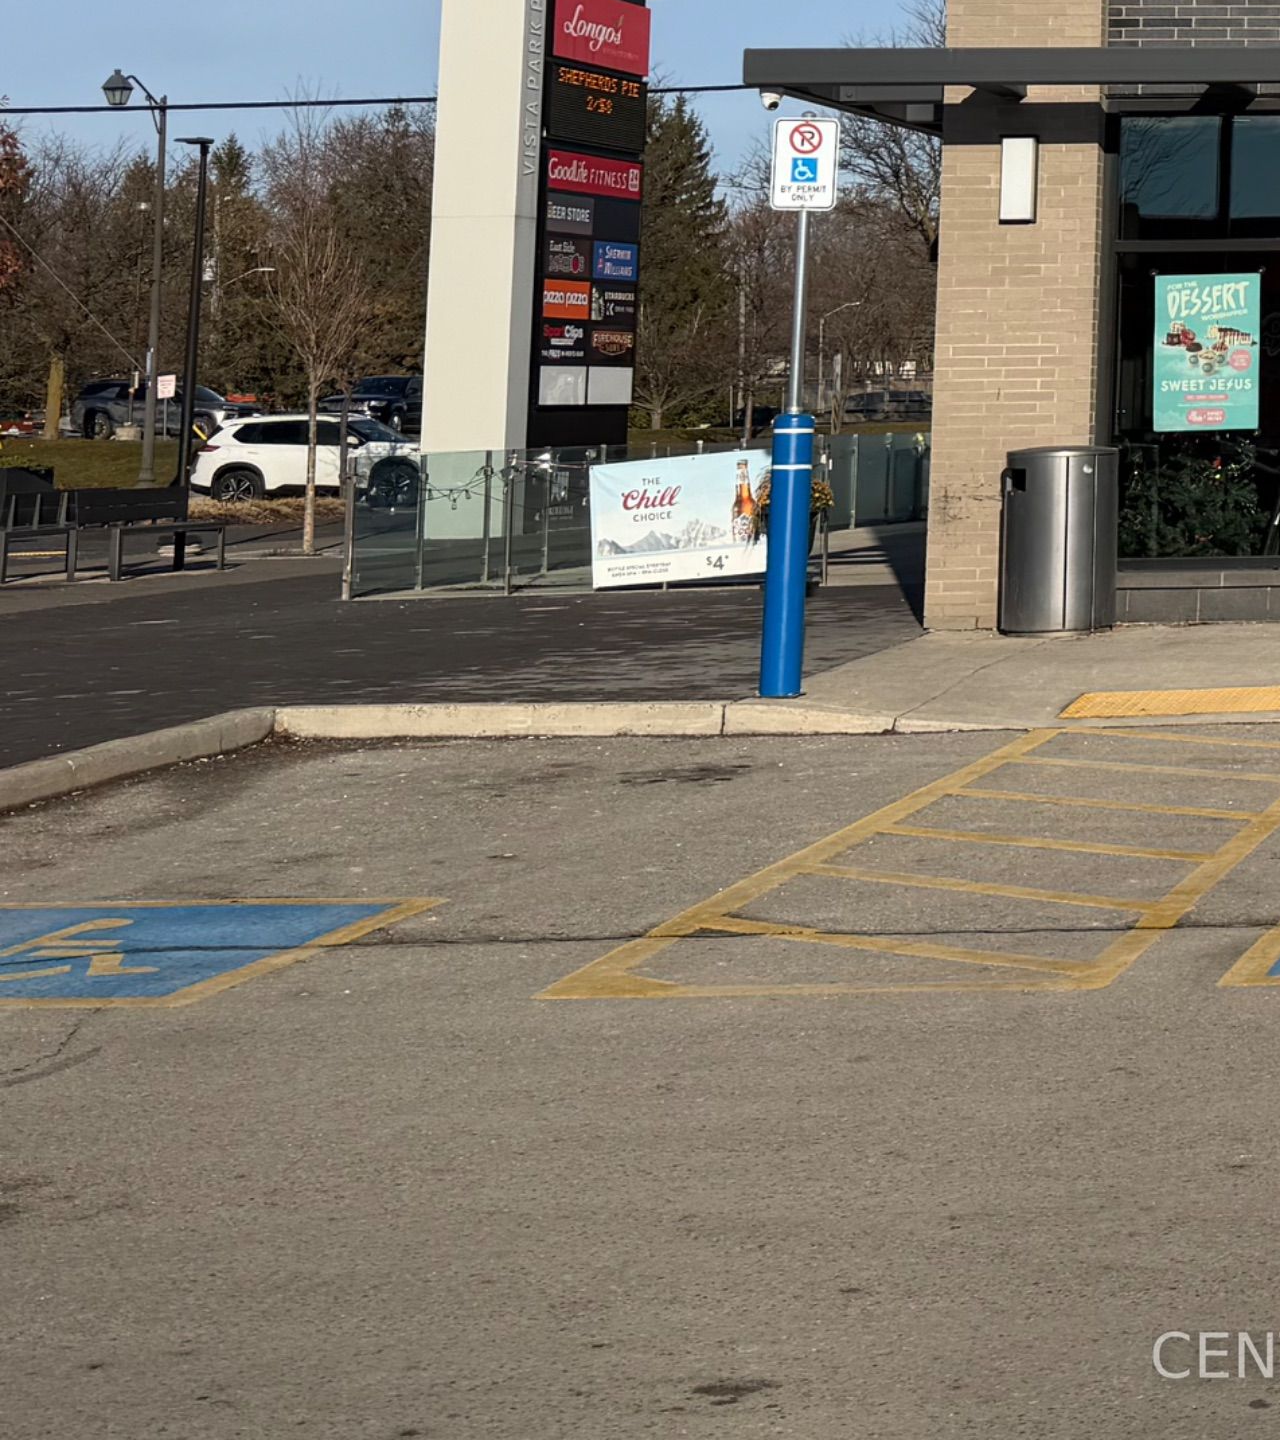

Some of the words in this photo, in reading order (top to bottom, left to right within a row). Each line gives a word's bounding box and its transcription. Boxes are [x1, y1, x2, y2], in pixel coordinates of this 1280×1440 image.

[527, 20, 543, 91] PARK
[557, 66, 618, 93] SHEPHERDS
[621, 80, 640, 98] PIE
[523, 99, 540, 176] VISTA
[589, 168, 627, 189] FITNESS
[567, 207, 590, 223] STORE
[1166, 281, 1250, 319] DESSERT
[1161, 379, 1205, 392] SWEET
[642, 477, 661, 486] THE
[622, 485, 682, 511] Chill
[632, 511, 672, 523] CHOICE
